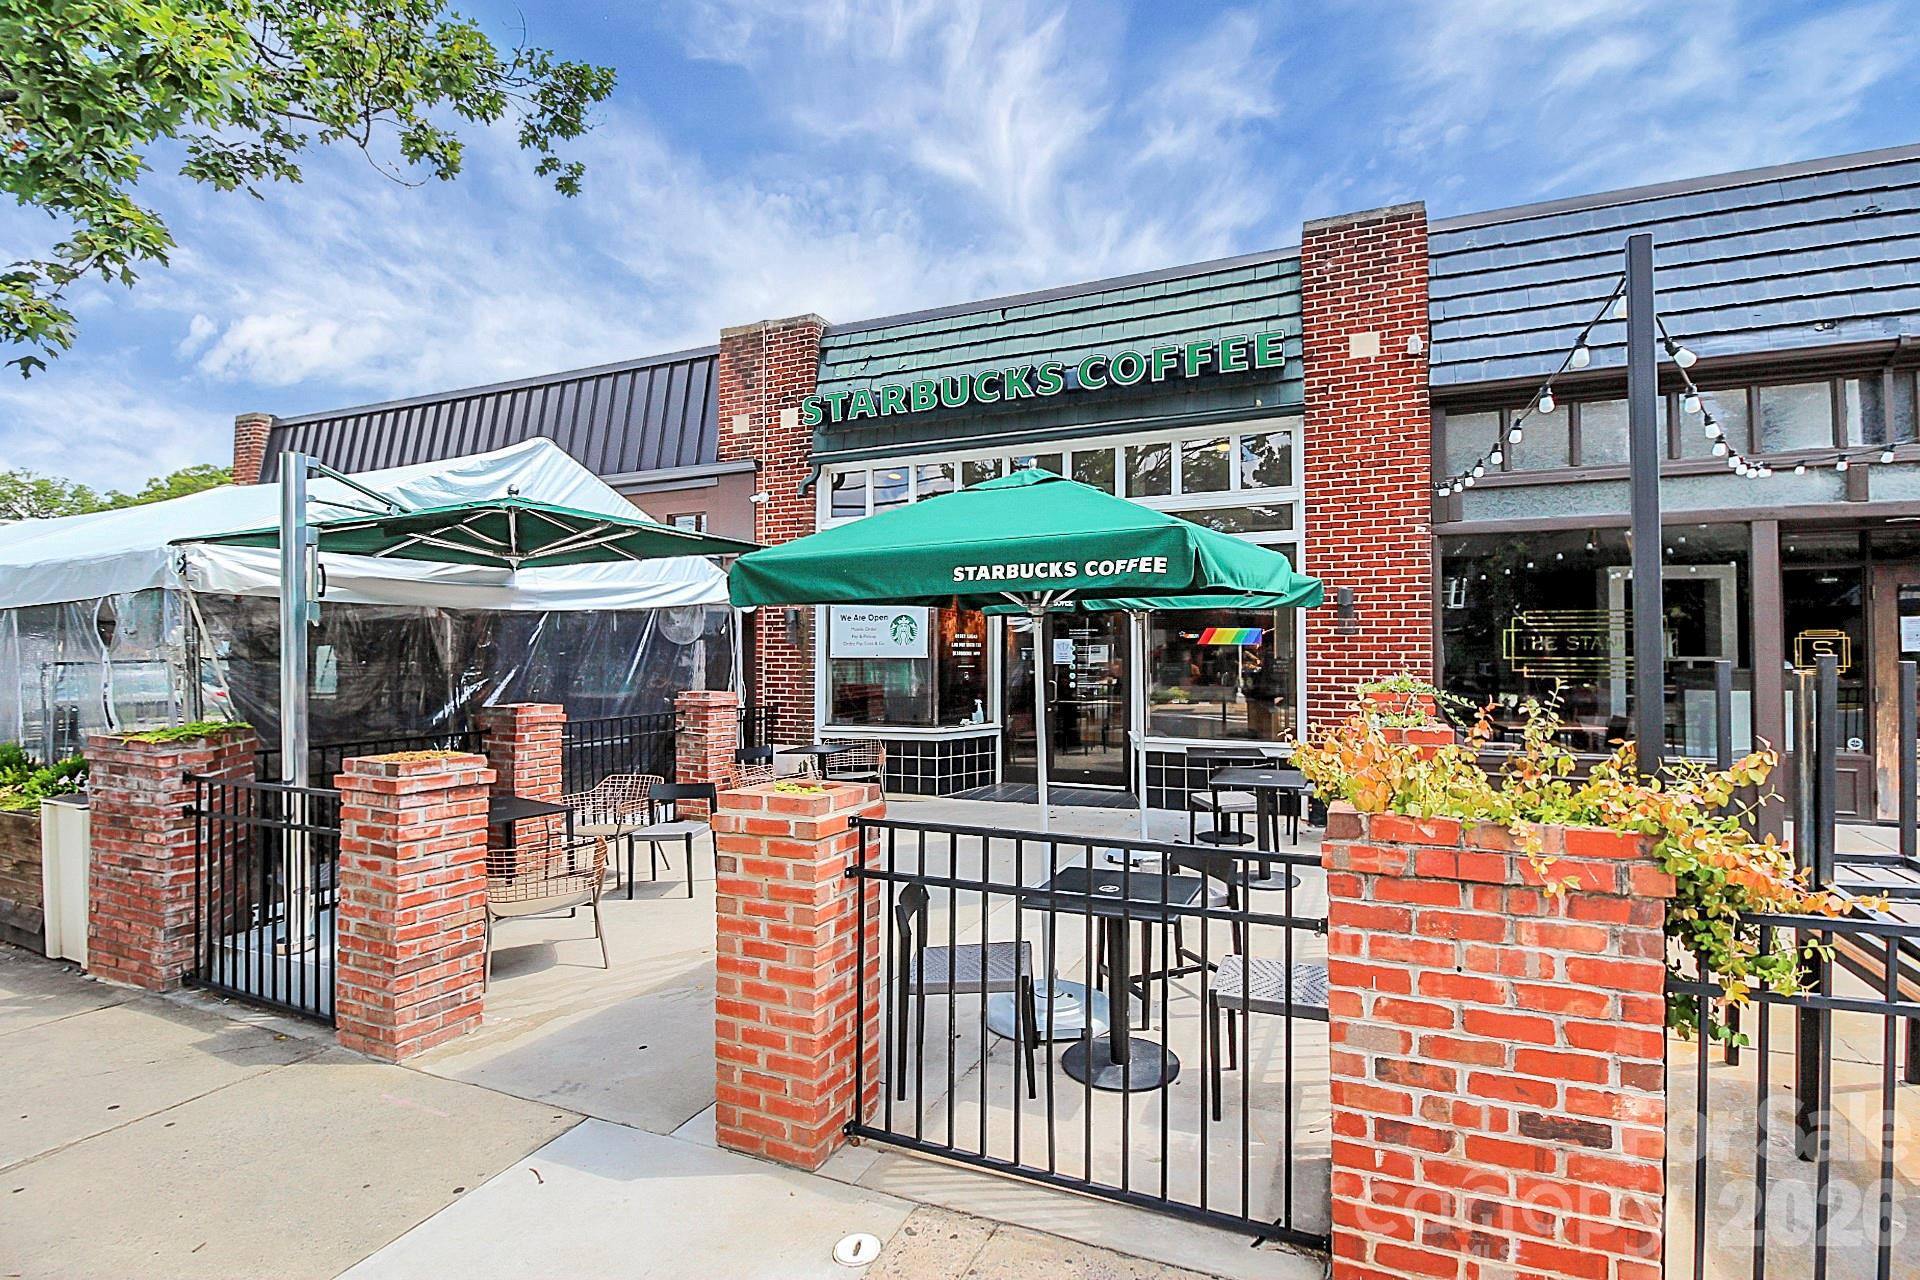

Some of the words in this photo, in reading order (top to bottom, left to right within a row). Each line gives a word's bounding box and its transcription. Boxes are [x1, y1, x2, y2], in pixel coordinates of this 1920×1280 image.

[801, 361, 1064, 425] STARBUCKS
[1077, 330, 1286, 389] COFFEE
[953, 561, 1077, 582] STARBUCKS
[1084, 557, 1168, 577] COFFEE
[840, 614, 852, 622] We
[853, 614, 867, 622] Are
[868, 614, 889, 623] Open
[1519, 636, 1558, 651] THE
